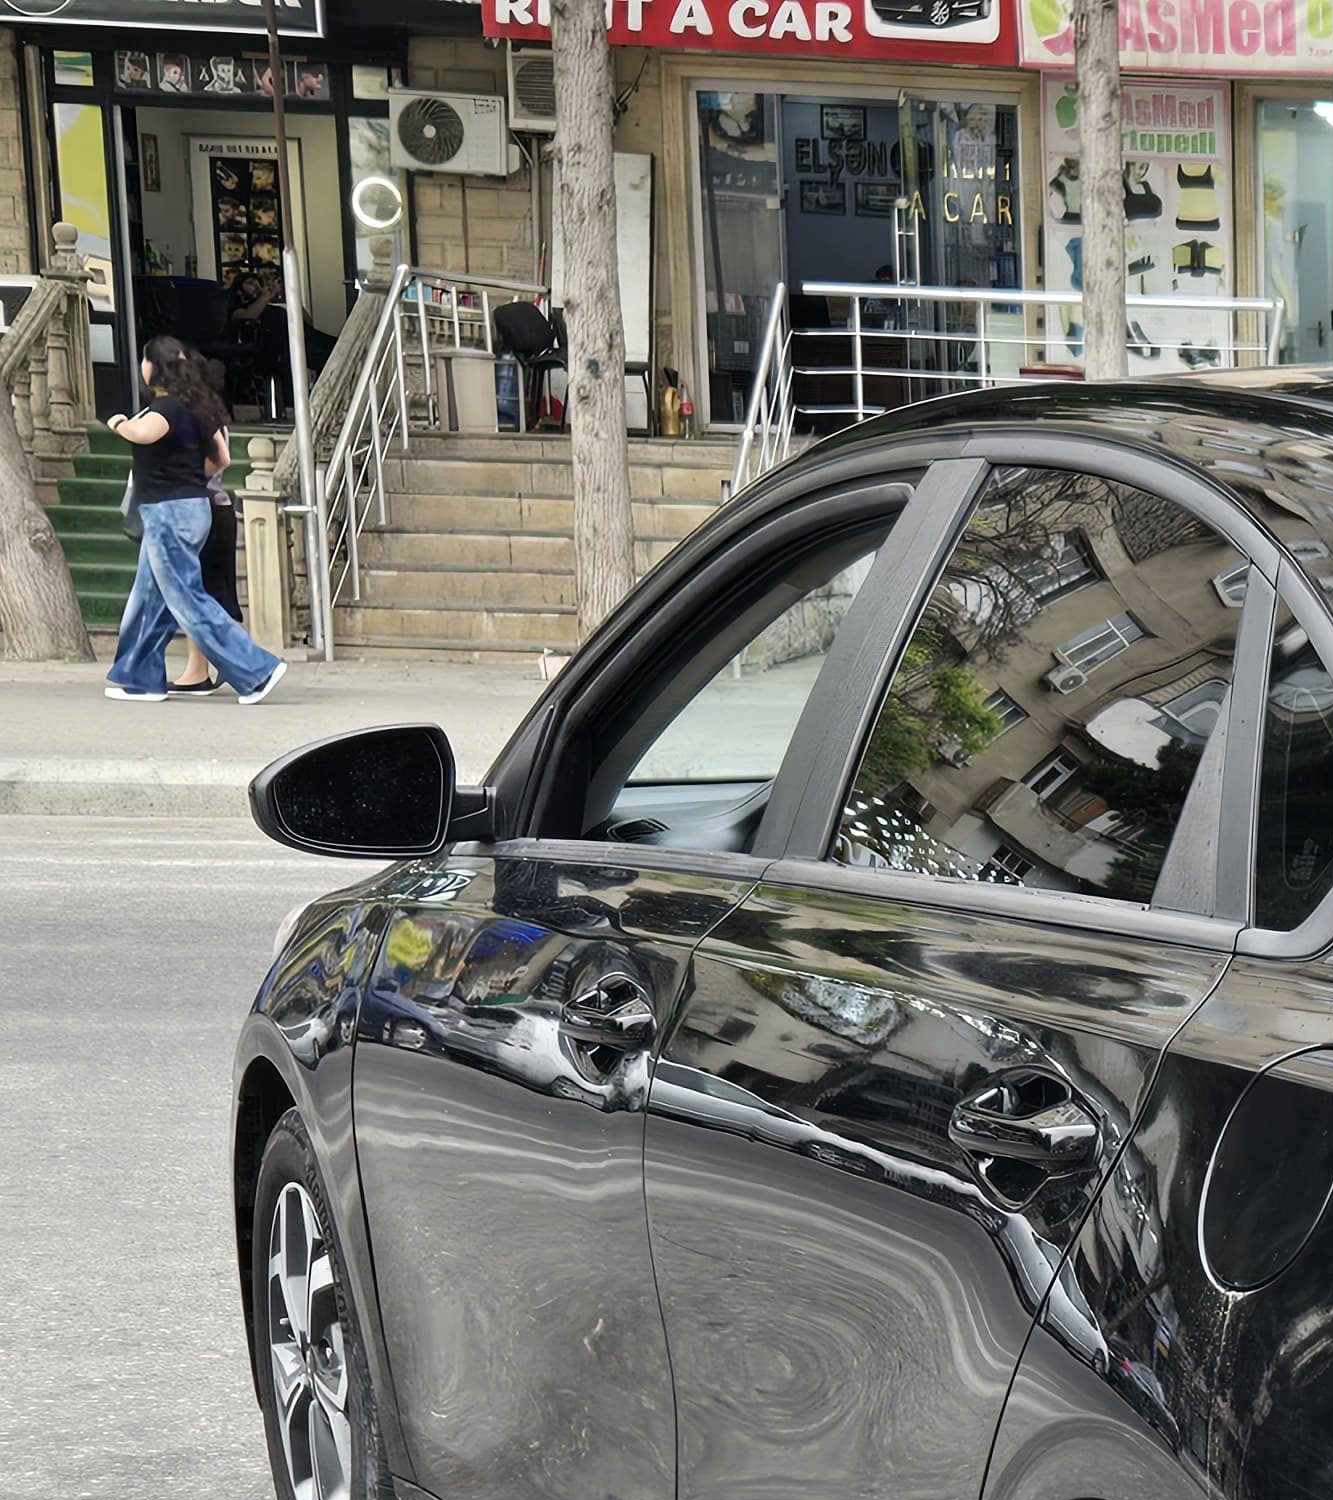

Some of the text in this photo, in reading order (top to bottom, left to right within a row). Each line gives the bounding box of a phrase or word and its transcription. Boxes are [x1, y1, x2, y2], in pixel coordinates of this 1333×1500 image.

[495, 0, 853, 43] RT A CAR
[943, 192, 1012, 225] CAR
